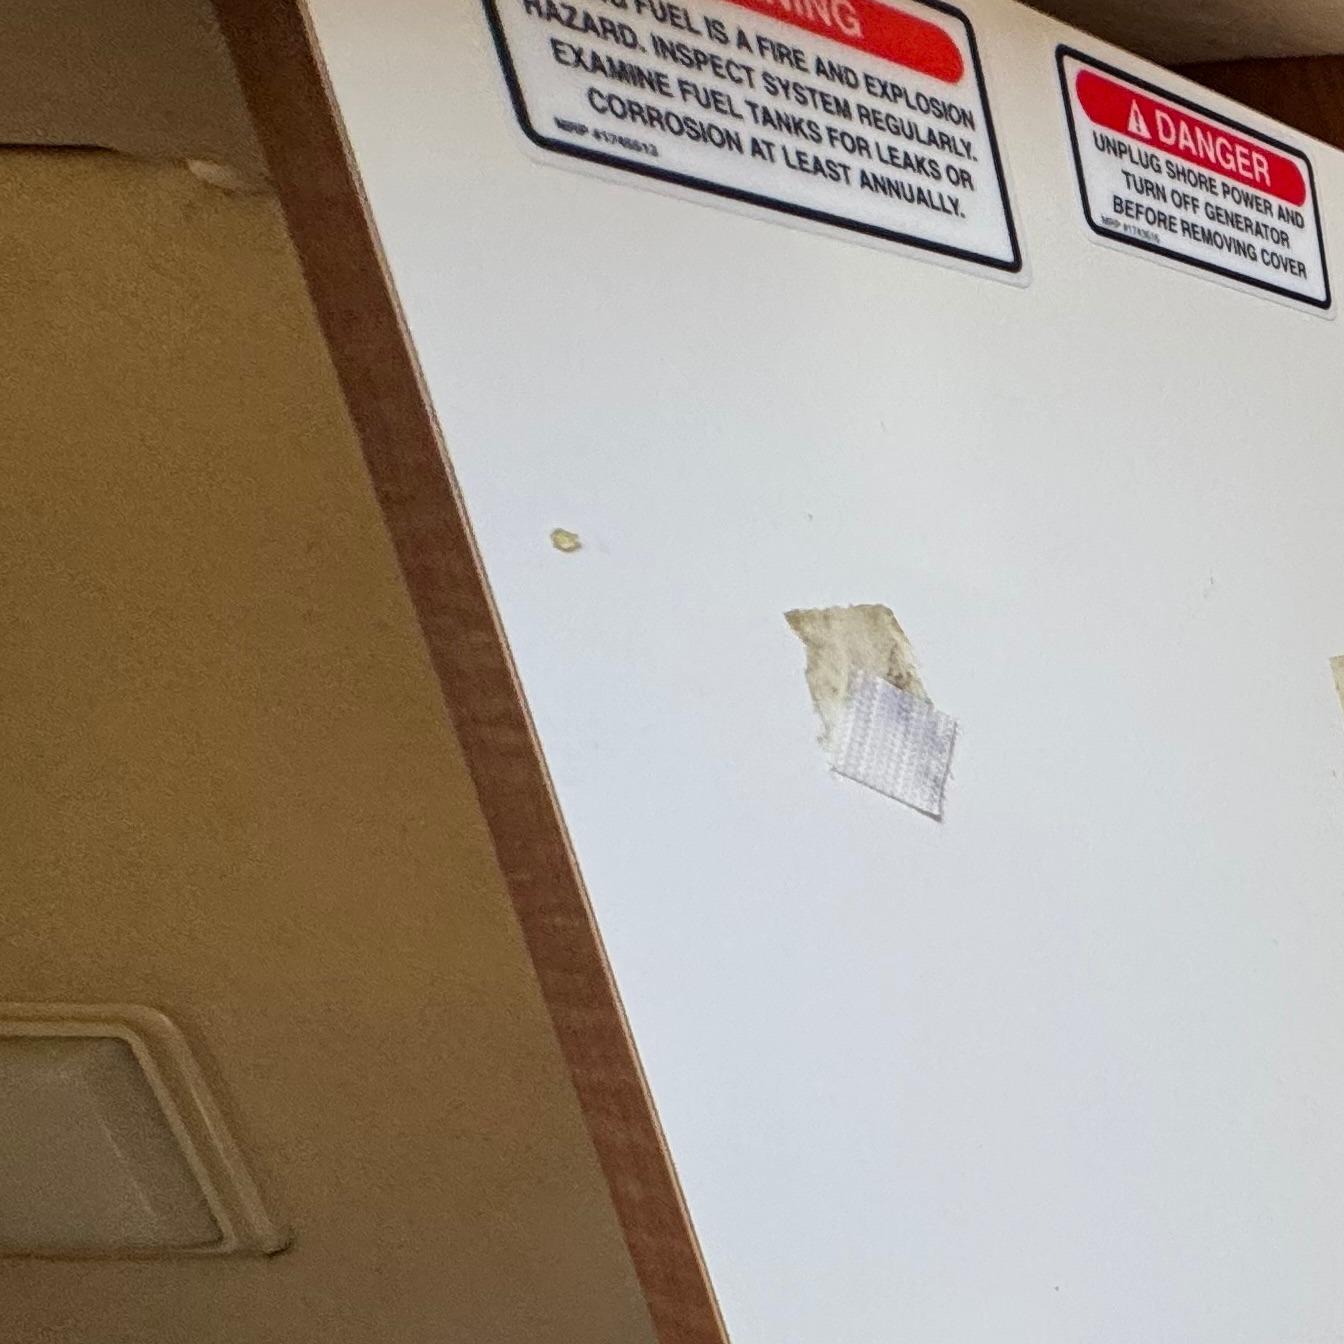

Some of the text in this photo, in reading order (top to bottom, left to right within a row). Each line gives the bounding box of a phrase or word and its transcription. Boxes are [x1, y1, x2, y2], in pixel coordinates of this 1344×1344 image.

[522, 0, 979, 163] HAZARD. INSPECT SYSTEM REGULARLY.
[549, 37, 976, 191] EXAMINE FUEL TANKS FOR LEAKS OR
[703, 16, 730, 45] IS
[736, 25, 754, 54] A
[755, 34, 810, 73] FIRE
[814, 55, 860, 90] AND
[863, 71, 977, 132] EXPLOSION
[586, 85, 745, 155] CORROSION
[749, 136, 776, 163] AT
[780, 144, 853, 186] LEAST
[858, 168, 967, 219] ANNUALLY.
[1092, 129, 1306, 230] UNPLUG SHORE POWER AND
[1154, 109, 1273, 189] DANGER
[1112, 193, 1179, 235] BEFORE
[1180, 218, 1259, 263] REMOVING
[1261, 247, 1309, 280] COVER
[1120, 168, 1168, 205] TURN
[1170, 189, 1201, 215] OFF
[1203, 202, 1291, 250] GENERATOR
